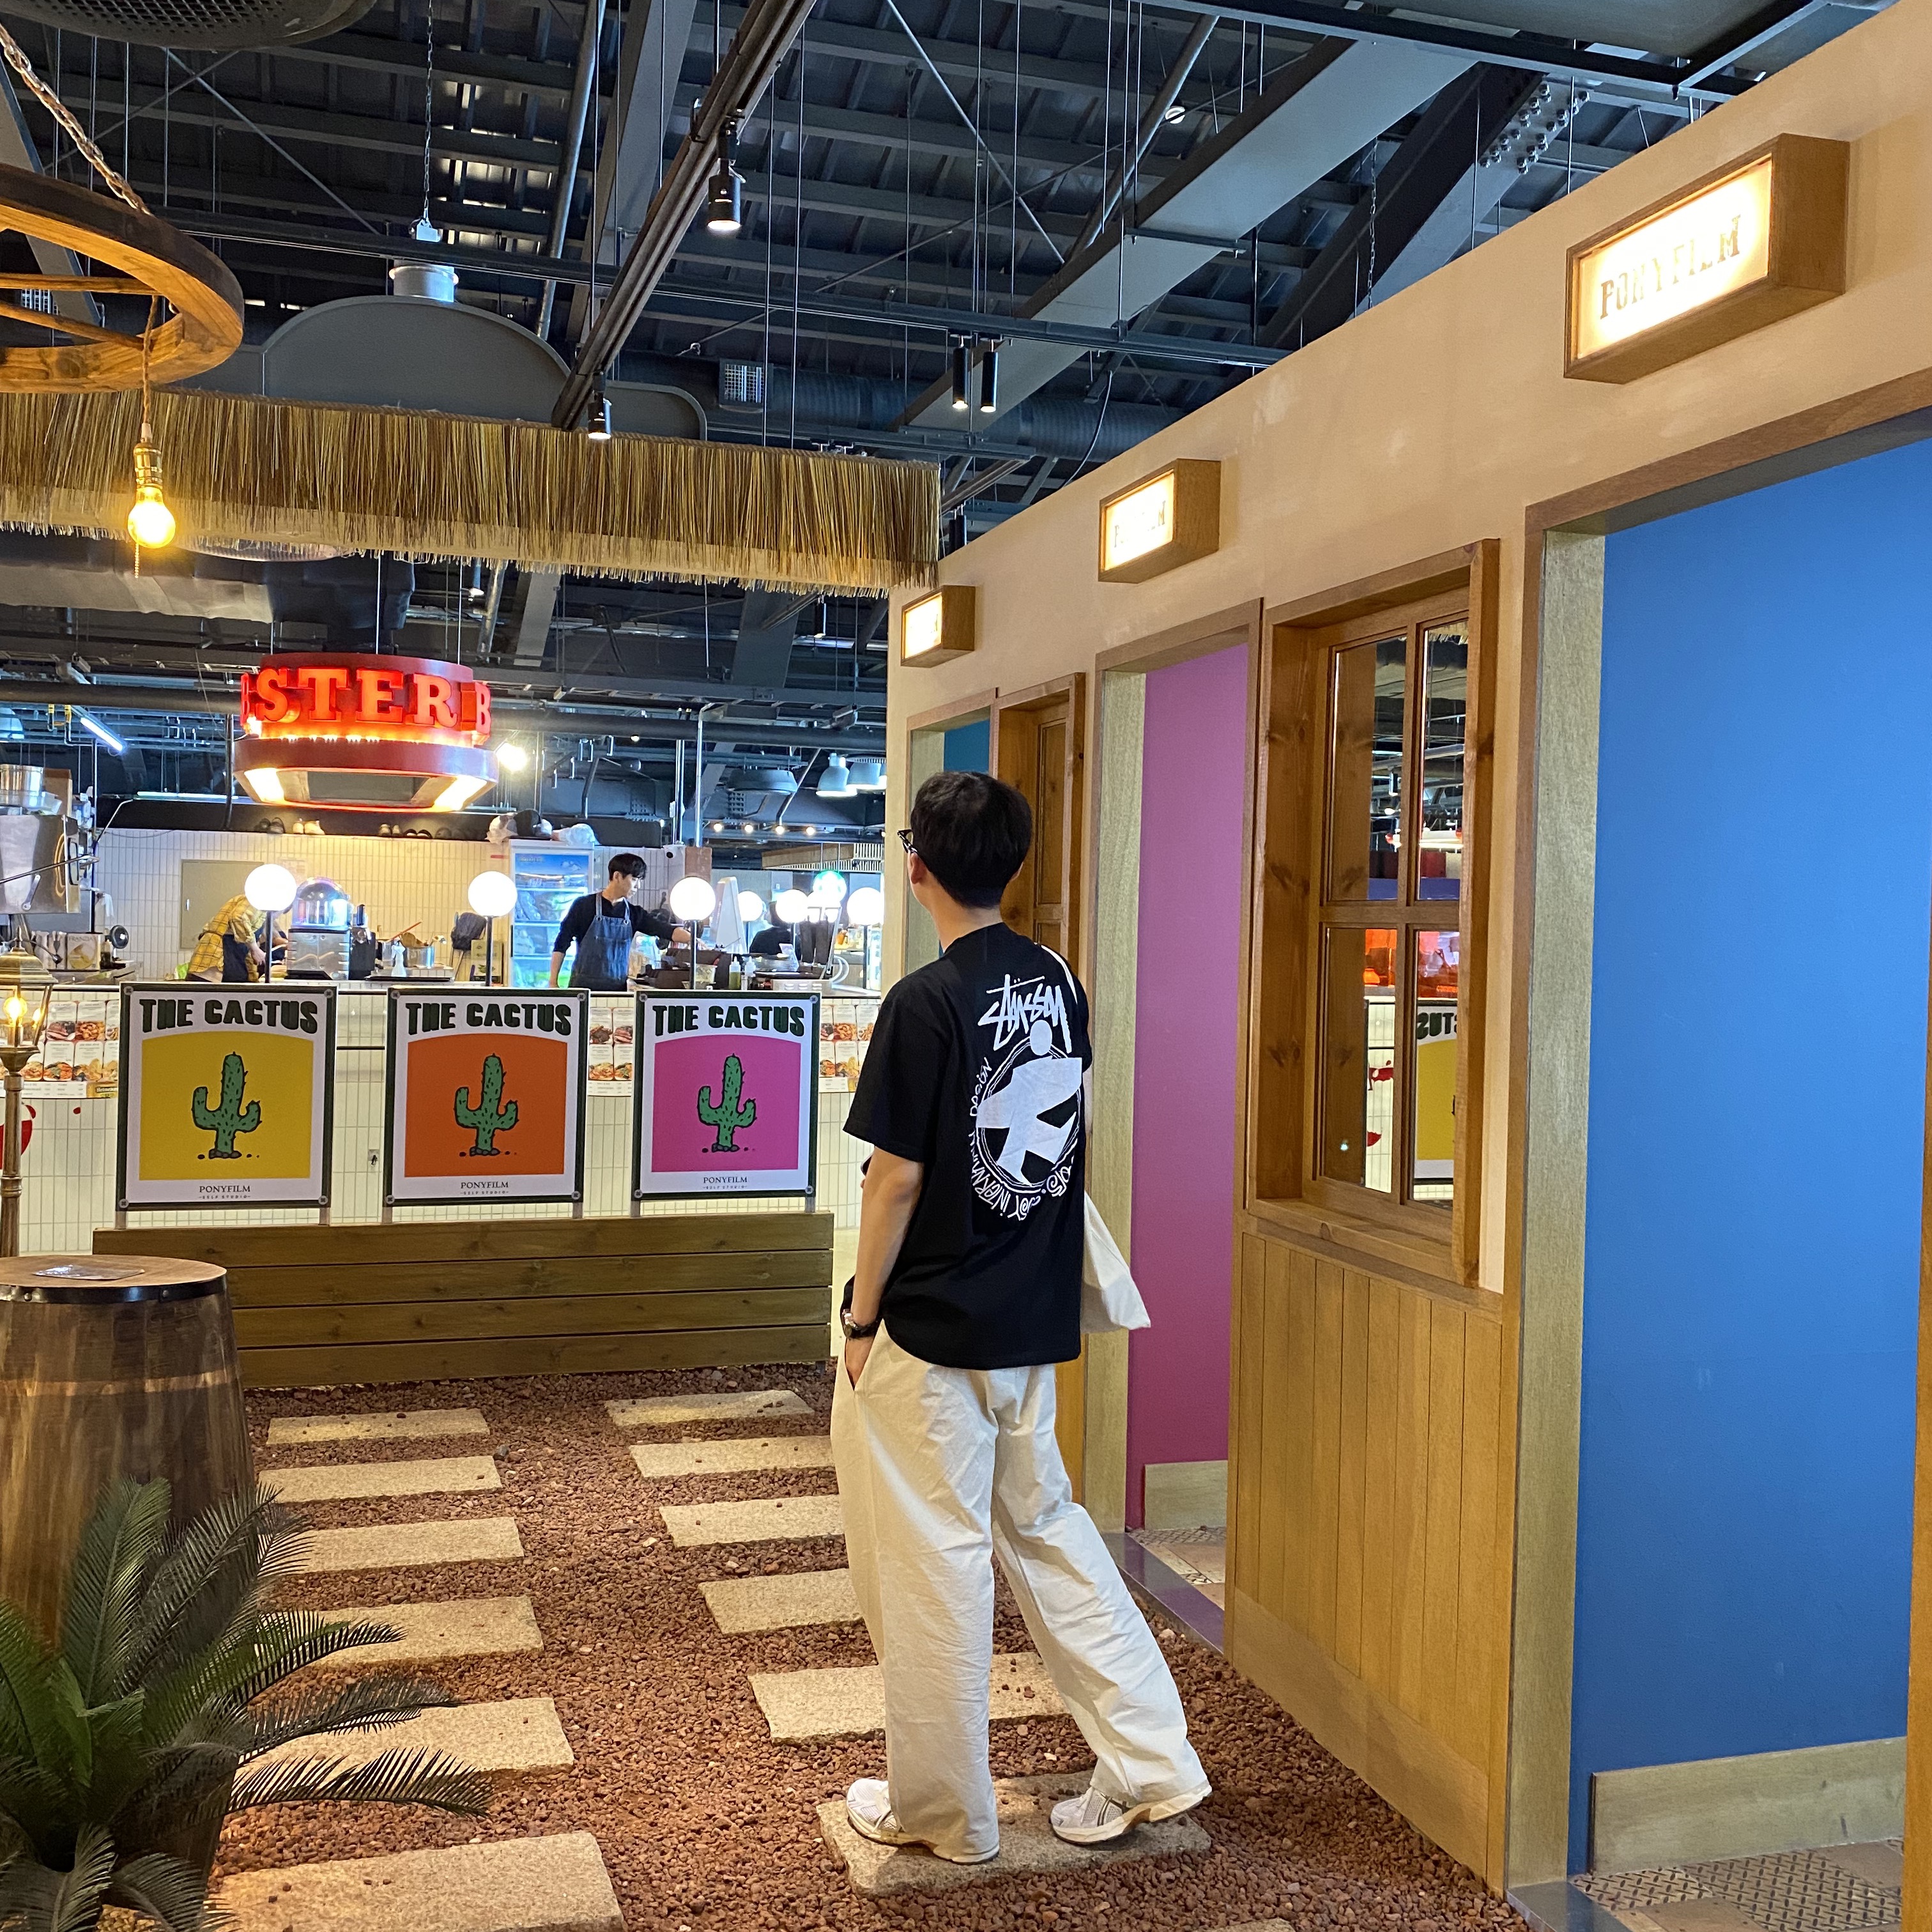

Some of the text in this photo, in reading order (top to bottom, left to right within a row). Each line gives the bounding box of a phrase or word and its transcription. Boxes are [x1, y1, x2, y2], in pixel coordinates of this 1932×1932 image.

[139, 999, 194, 1032] THE
[204, 999, 318, 1034] CACTUS
[405, 1002, 456, 1035] THE
[466, 1003, 571, 1036] CACTUS
[652, 1006, 699, 1036] THE
[708, 1006, 804, 1037] CACTUS
